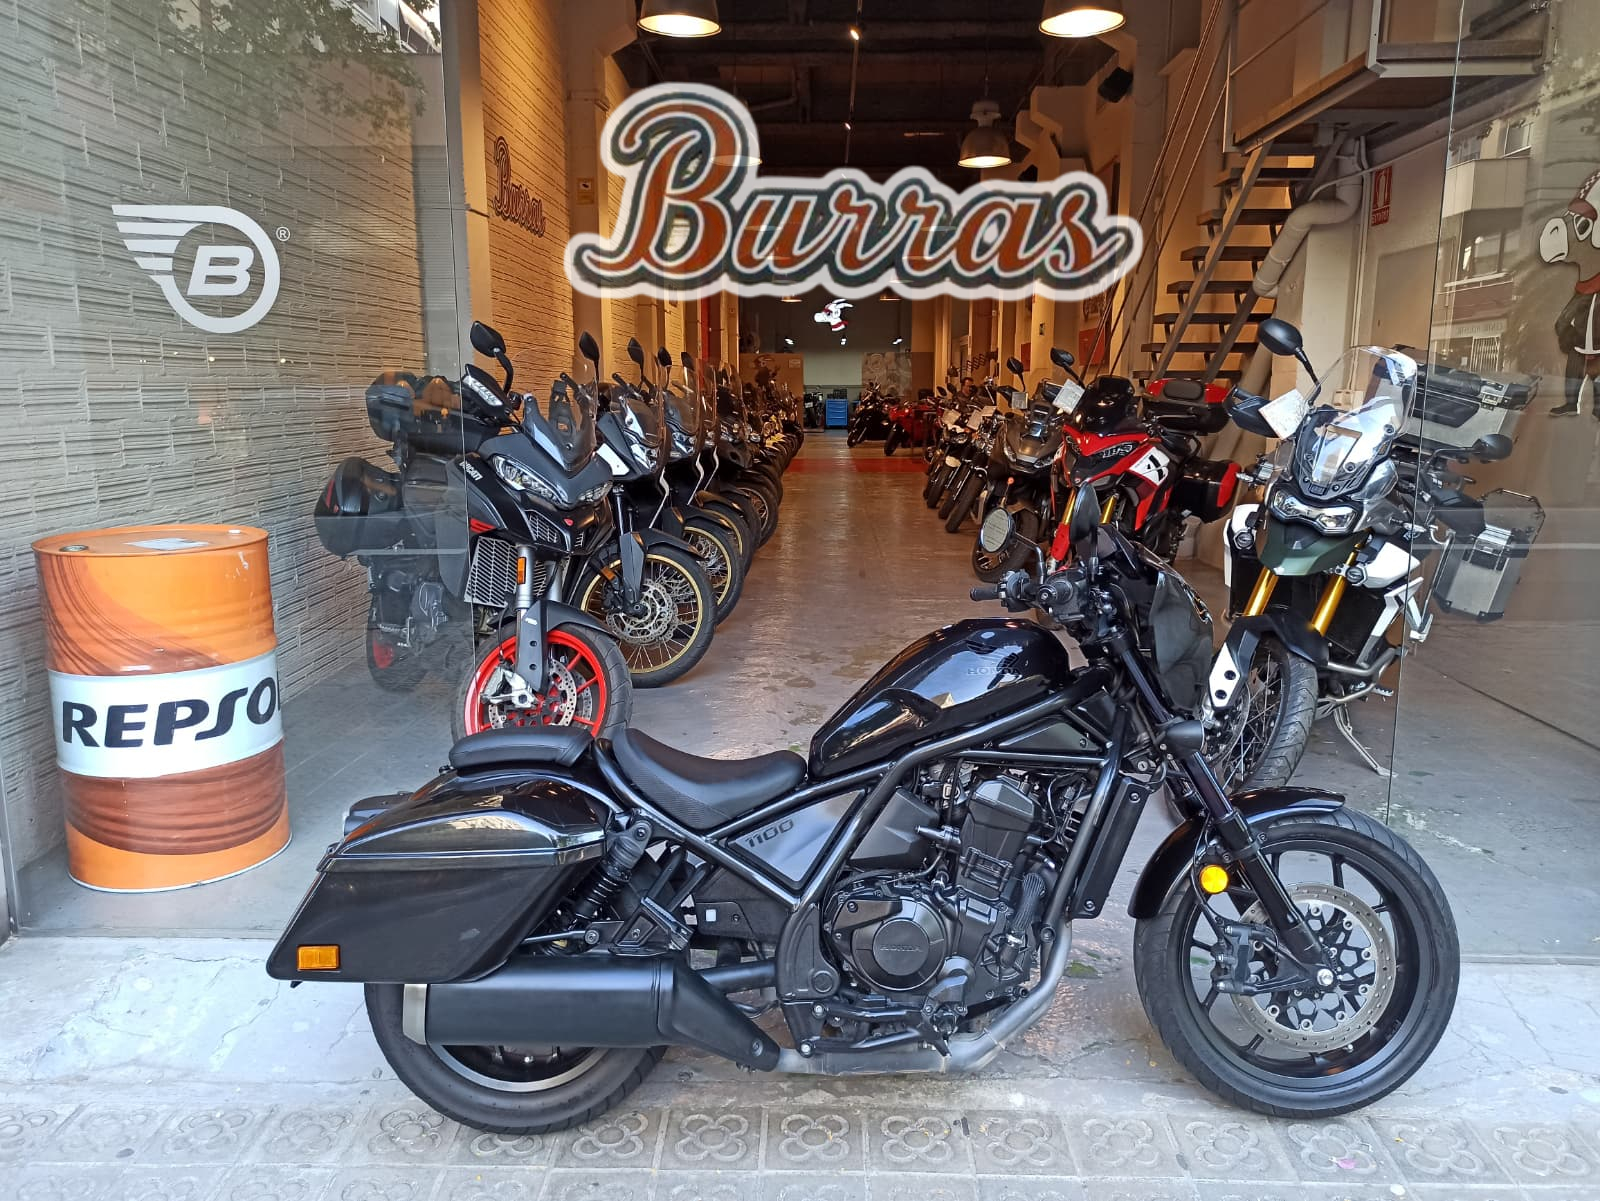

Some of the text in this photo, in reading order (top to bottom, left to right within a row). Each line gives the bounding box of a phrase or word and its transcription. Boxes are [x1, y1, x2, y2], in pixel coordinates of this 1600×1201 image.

[572, 90, 1135, 288] Burras
[187, 245, 254, 296] B
[744, 819, 794, 847] 1100
